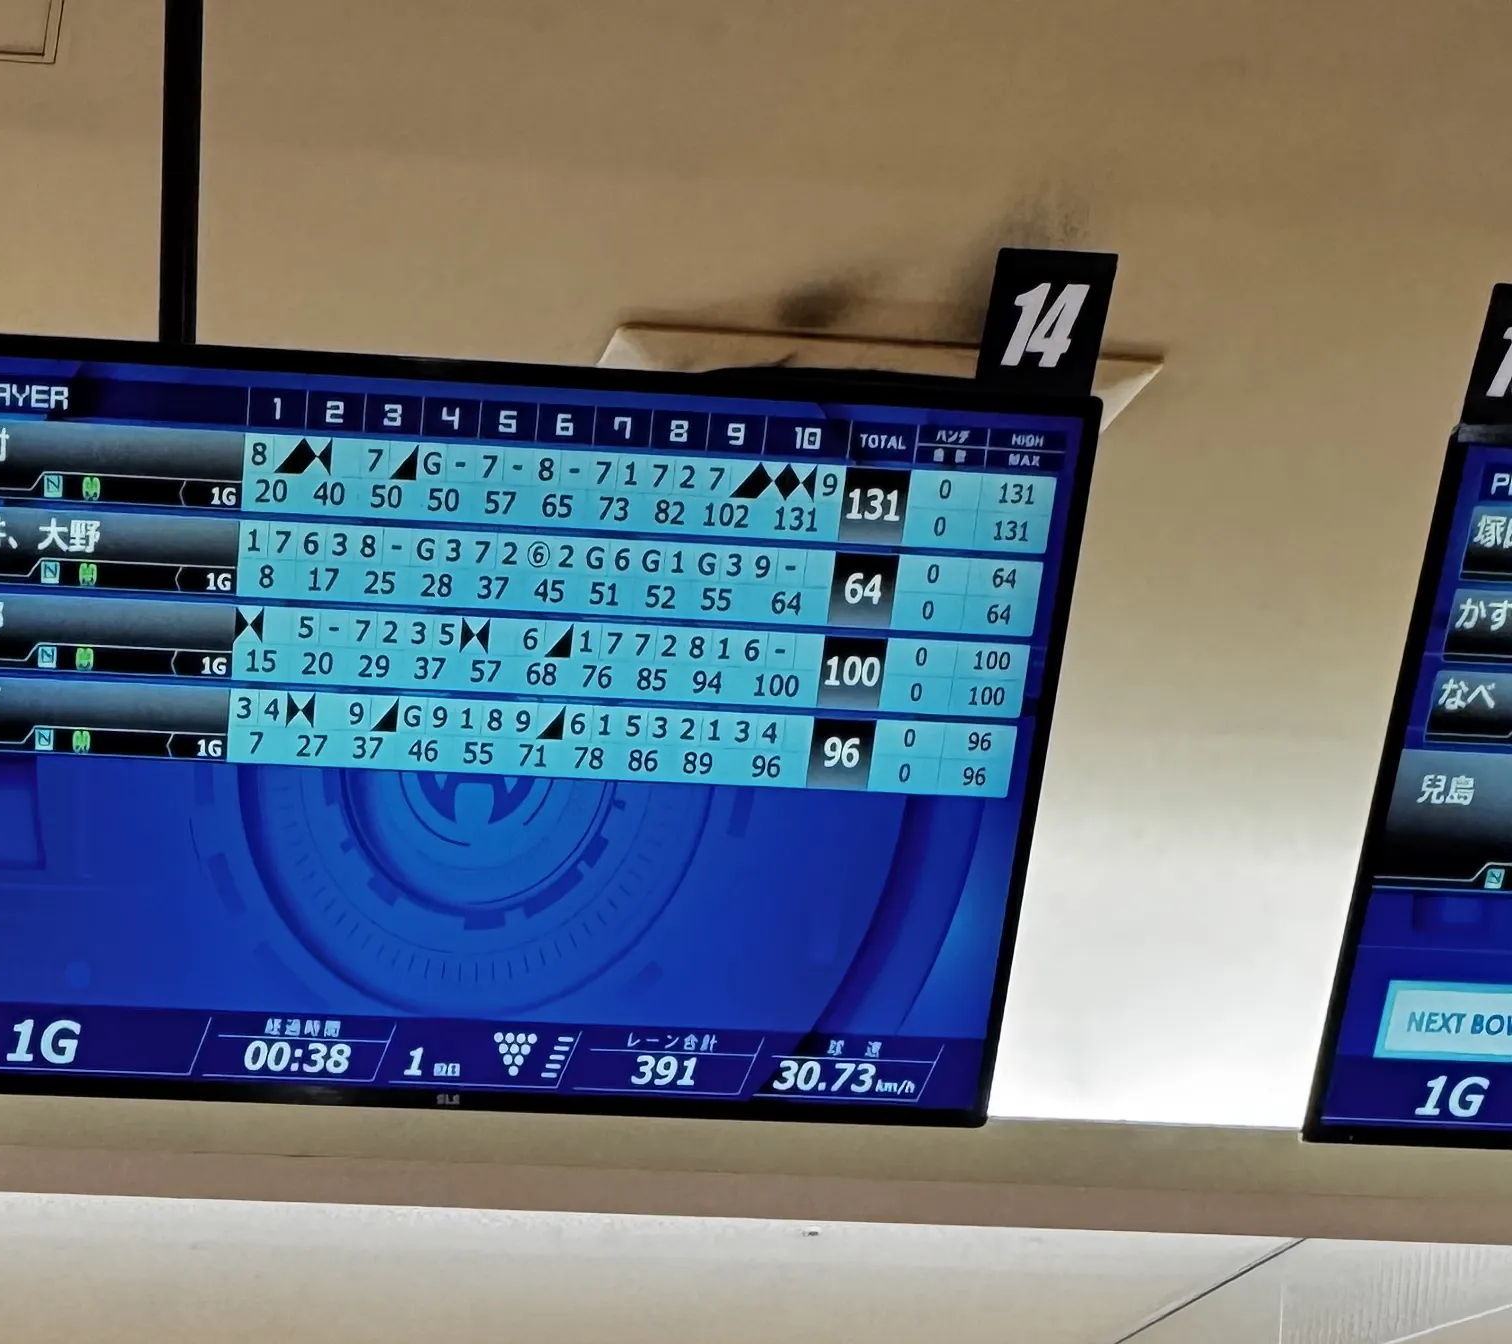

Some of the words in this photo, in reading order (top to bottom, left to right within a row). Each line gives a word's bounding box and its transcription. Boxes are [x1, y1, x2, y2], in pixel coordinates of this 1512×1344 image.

[1000, 282, 1090, 368] 14
[1486, 326, 1512, 397] 1
[273, 397, 282, 420] 1
[325, 400, 344, 423] 2
[383, 404, 402, 426] 3
[441, 407, 460, 430] 4
[498, 410, 518, 433] 5
[556, 413, 574, 436] 6
[669, 420, 689, 442] 8
[727, 423, 746, 446] 9
[795, 427, 822, 450] 10
[860, 434, 906, 450] TOTAL
[1008, 453, 1040, 467] MAX
[210, 486, 236, 506] 1G
[255, 478, 288, 503] 20
[313, 481, 345, 506] 40
[370, 484, 402, 509] 50
[427, 488, 460, 512] 50
[484, 490, 517, 515] 57
[542, 493, 574, 518] 65
[599, 496, 630, 522] 73
[654, 499, 685, 526] 82
[703, 502, 749, 528] 102
[774, 506, 818, 532] 131
[846, 488, 900, 522] 131
[206, 572, 232, 591] 1G
[308, 567, 340, 592] 17
[364, 570, 396, 595] 25
[420, 573, 452, 598] 28
[477, 575, 509, 600] 37
[534, 578, 565, 604] 45
[589, 582, 619, 606] 51
[645, 584, 676, 610] 52
[700, 587, 732, 612] 55
[771, 591, 802, 616] 64
[844, 572, 882, 605] 64
[201, 656, 227, 675] 1G
[246, 649, 277, 673] 15
[301, 652, 333, 675] 20
[753, 673, 800, 698] 100
[824, 656, 881, 687] 100
[197, 739, 222, 757] 1G
[296, 734, 328, 757] 27
[352, 736, 384, 759] 37
[408, 739, 438, 762] 46
[463, 741, 494, 765] 55
[519, 744, 547, 768] 71
[574, 746, 604, 770] 78
[628, 749, 658, 772] 86
[682, 751, 713, 775] 89
[752, 754, 781, 778] 96
[824, 736, 860, 768] 96
[6, 1019, 81, 1064] 1G
[1406, 1011, 1467, 1034] NEXT
[244, 1040, 352, 1074] 00:38
[403, 1047, 424, 1076] 1
[631, 1055, 697, 1086] 391
[772, 1060, 876, 1093] 30.73
[1414, 1075, 1490, 1117] 1G
